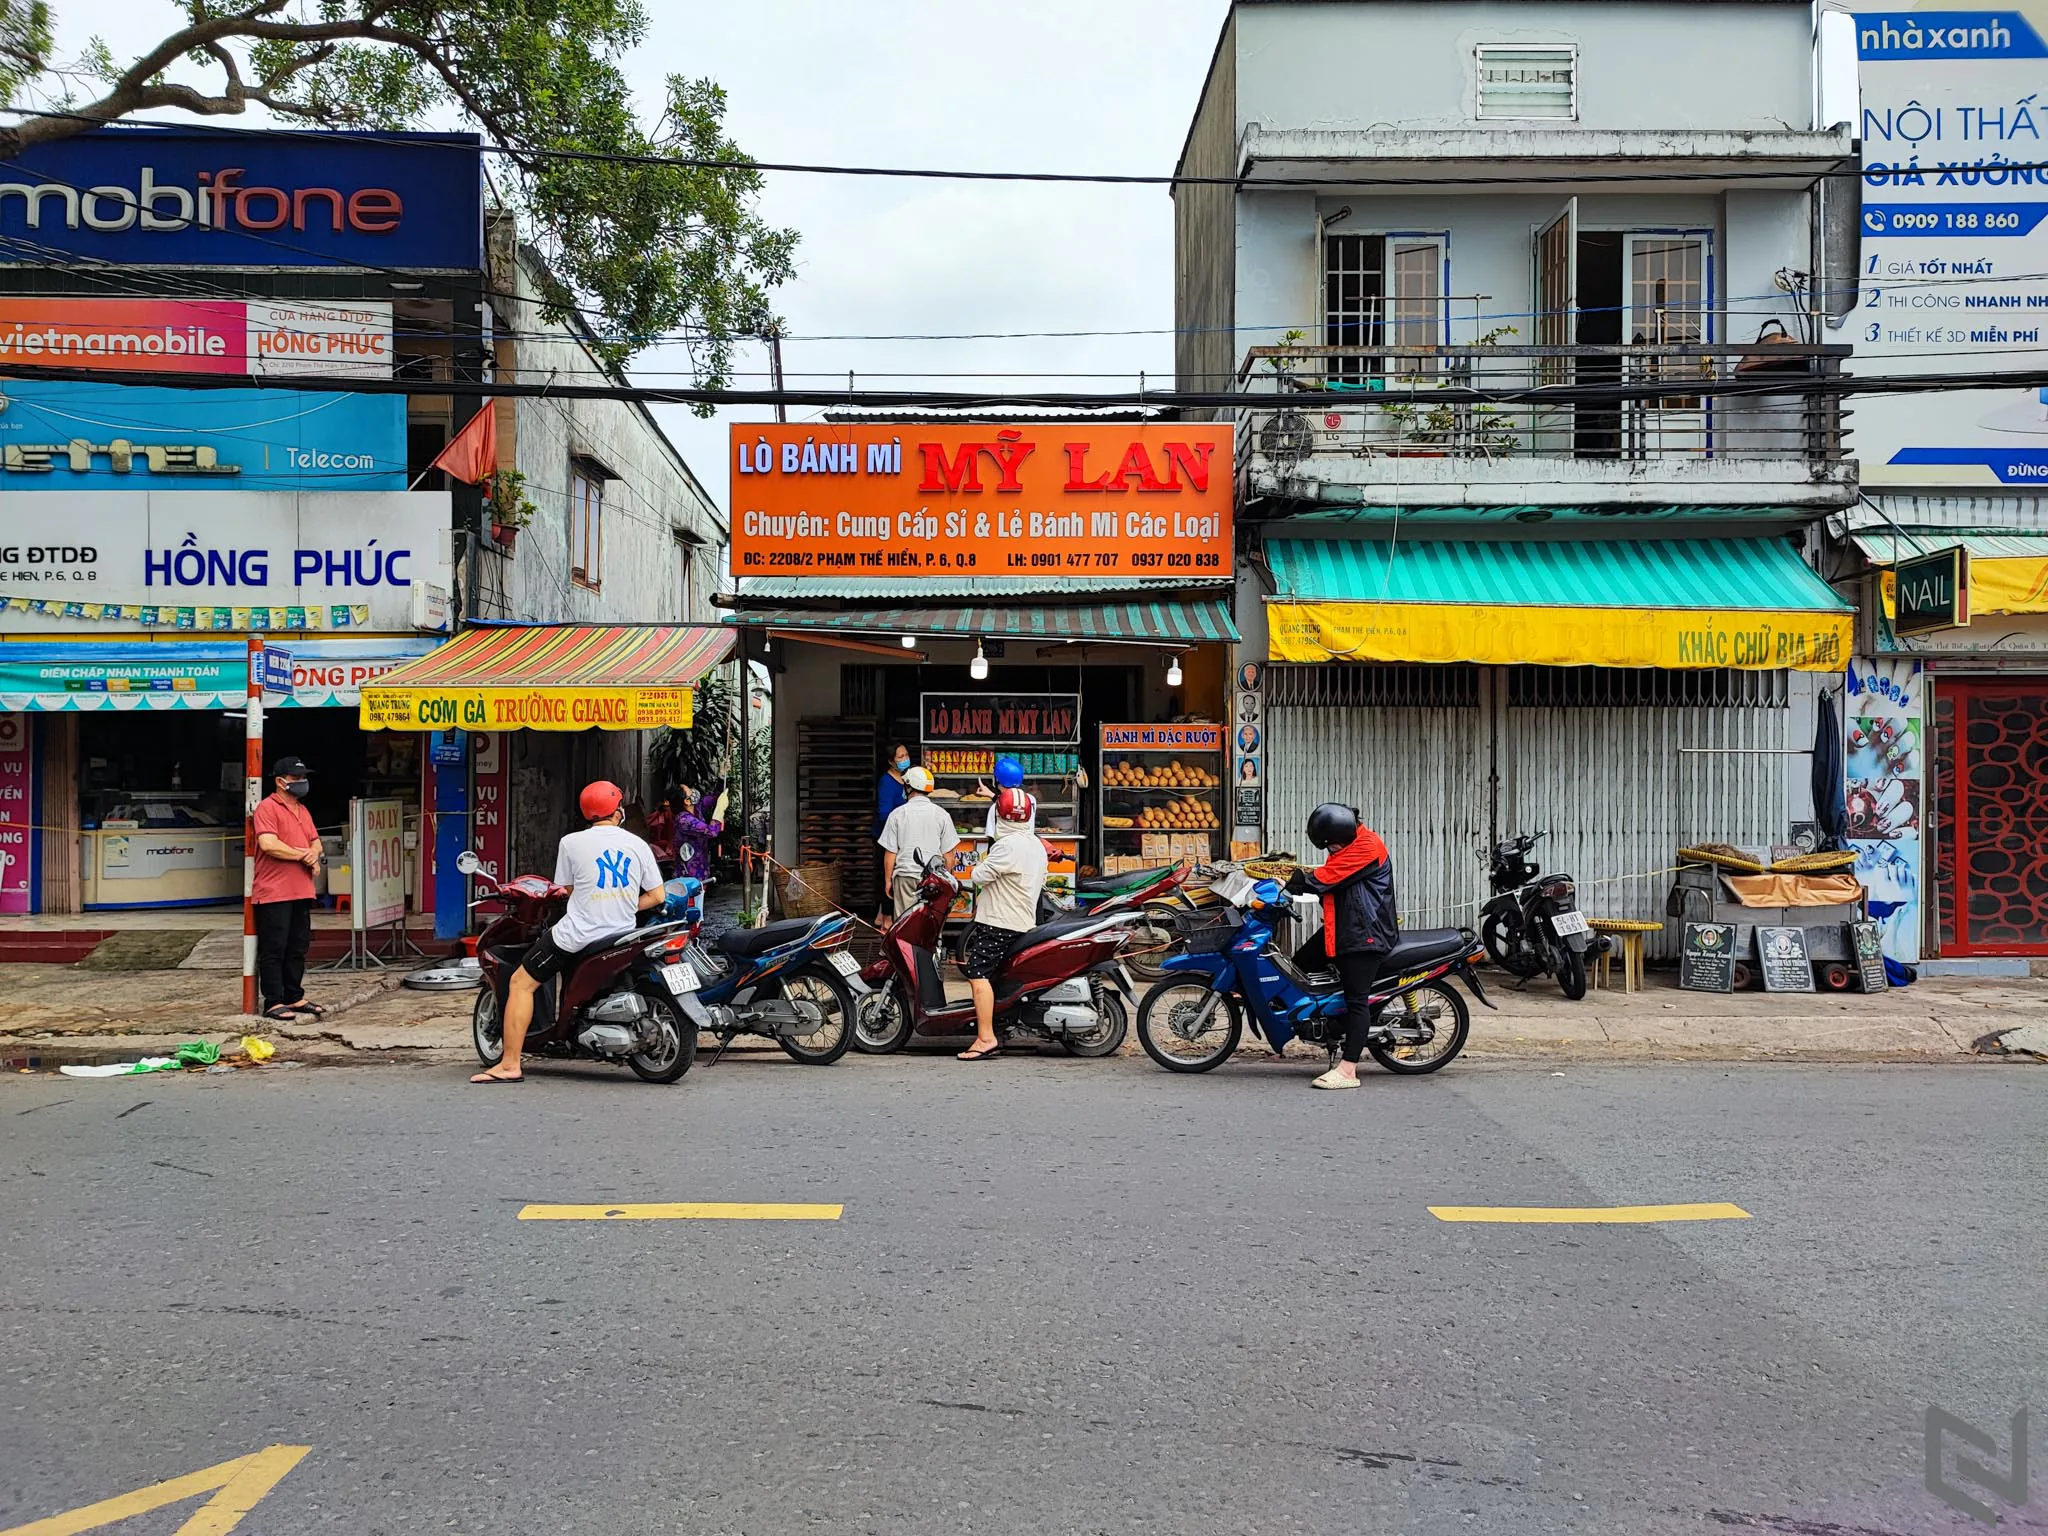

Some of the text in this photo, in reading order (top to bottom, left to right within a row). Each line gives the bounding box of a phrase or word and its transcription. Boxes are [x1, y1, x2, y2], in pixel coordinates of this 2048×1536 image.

[1863, 100, 1941, 149] NỘI
[1864, 155, 1925, 186] GIÁ
[1892, 213, 2019, 229] 0909 188 860
[1888, 260, 1915, 275] GIÁ
[1919, 258, 1947, 275] TỐT
[1951, 257, 1993, 275] NHẤT
[1888, 296, 1908, 308] THI
[1911, 293, 1960, 308] CÔNG
[1965, 295, 2021, 308] NHANH
[0, 325, 227, 357] vietnamobile
[327, 327, 385, 355] PHÚC
[1888, 327, 1922, 343] THIẾT
[1926, 327, 1943, 343] KẾ
[1947, 331, 1966, 343] 3D
[1970, 325, 2008, 343] MIỄN
[2013, 328, 2039, 343] PHÍ
[1325, 433, 1340, 441] LG
[286, 447, 374, 469] Telecom
[739, 430, 1216, 493] LÒ BÁNH MÌ MỸ LAN
[743, 507, 1220, 542] Chuyên: Cung Cấp Sỉ & Lẻ Bánh Mì Các Loại
[27, 546, 97, 564] ĐTDĐ
[145, 533, 411, 586] HỒNG PHÚC
[743, 552, 766, 567] ĐC:
[769, 552, 815, 567] 2208/2
[817, 552, 856, 568] PHẠM
[859, 548, 885, 567] THẾ
[887, 547, 922, 568] HIỂN,
[955, 553, 977, 567] Q.8
[1007, 553, 1028, 567] LH:
[1031, 553, 1061, 567] 0901
[1067, 553, 1090, 567] 477
[1094, 553, 1118, 567] 707
[1131, 553, 1161, 567] 0937
[1166, 553, 1191, 567] 020
[1194, 553, 1220, 567] 838
[1901, 574, 1950, 613] NAIL
[1678, 616, 1728, 665] KHẮC
[1734, 623, 1772, 665] CHỮ
[1776, 632, 1807, 665] BIA
[144, 666, 184, 678] THANH
[187, 665, 219, 677] TOÁN
[390, 699, 411, 710] TRUNG
[418, 691, 629, 724] CƠM GÀ TRƯỜNG GIANG
[930, 702, 949, 735] LÒ
[951, 702, 993, 735] BÁNH
[998, 702, 1016, 735] MÌ
[1042, 708, 1072, 735] LAN
[1105, 727, 1217, 747] BÁNH MÌ ĐẶC RUỘT
[476, 786, 498, 802] VỤ
[595, 849, 632, 889] NY
